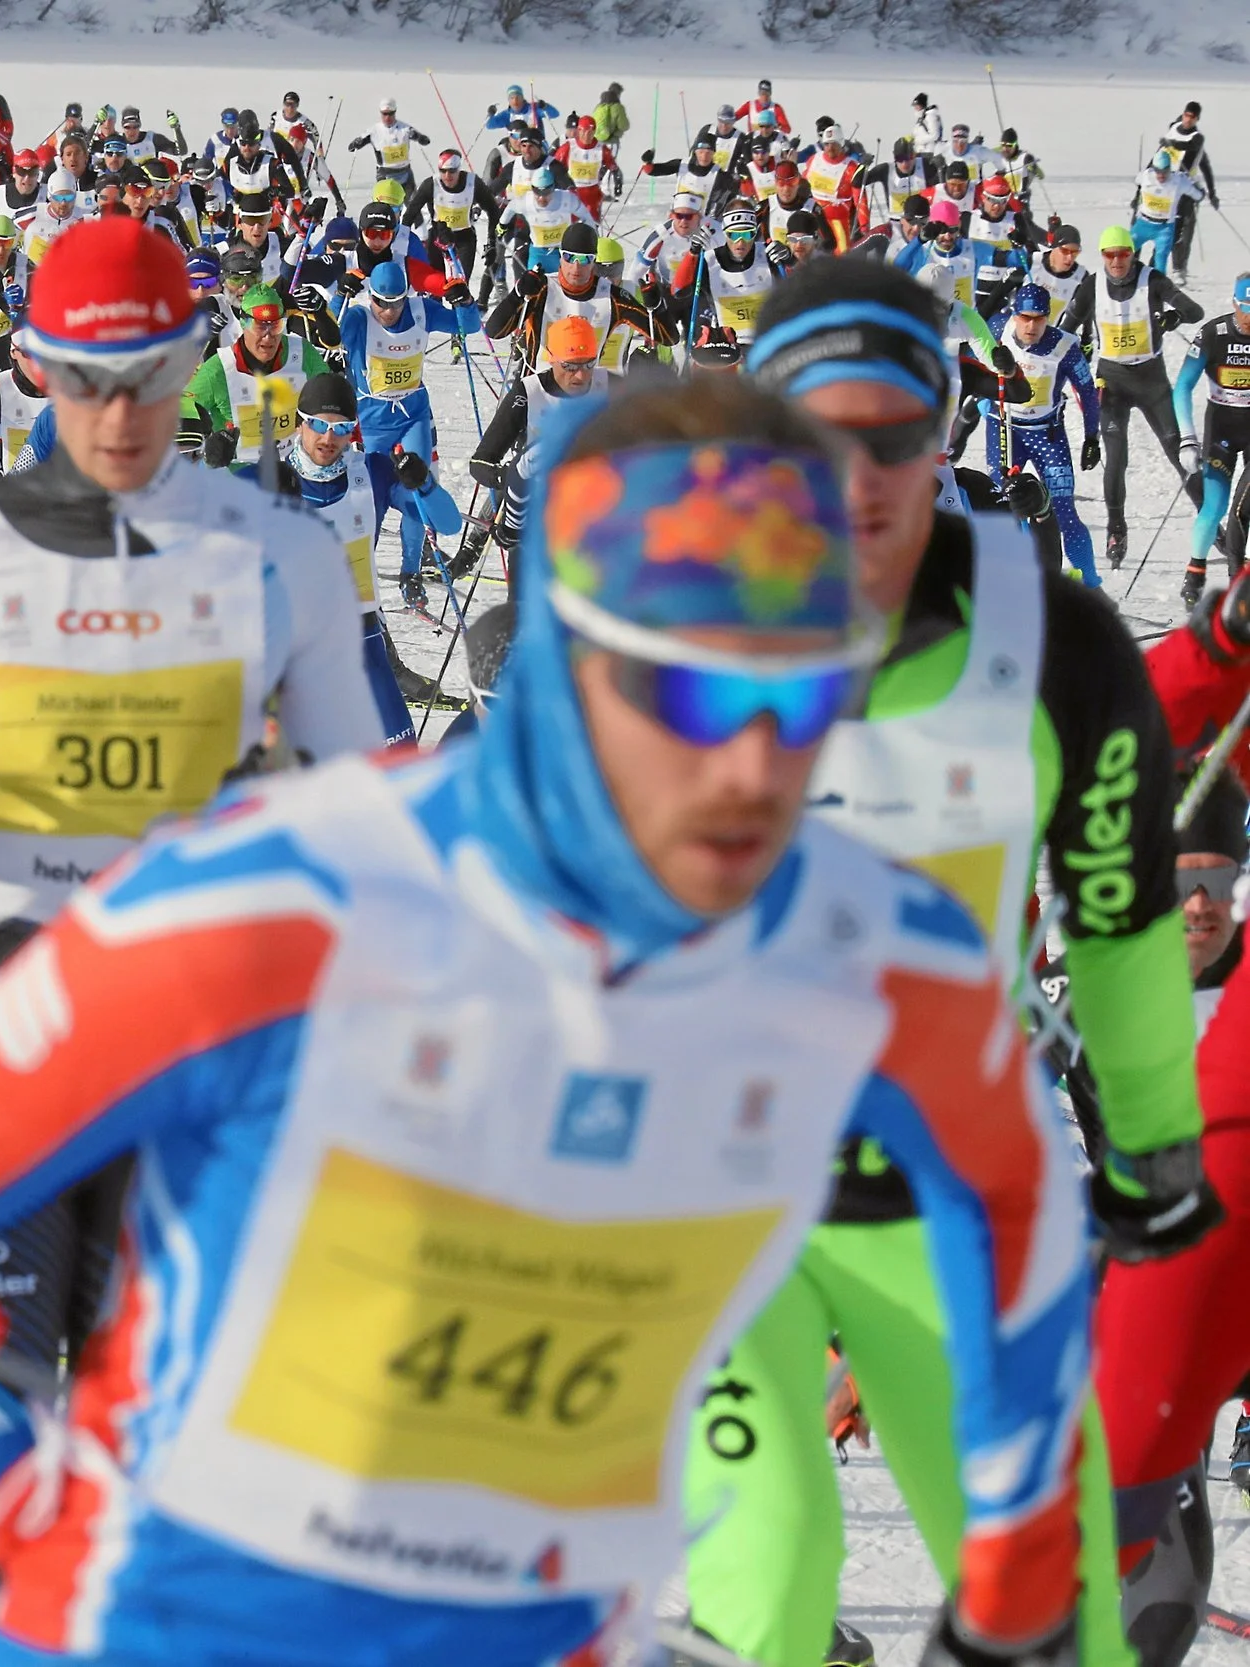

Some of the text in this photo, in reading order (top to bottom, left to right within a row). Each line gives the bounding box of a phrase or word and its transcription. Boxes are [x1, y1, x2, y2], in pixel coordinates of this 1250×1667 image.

[388, 344, 411, 353] coop
[1112, 334, 1137, 348] 555
[384, 370, 412, 385] 589
[55, 609, 162, 640] coop
[56, 733, 164, 793] 301
[385, 1311, 636, 1428] 446
